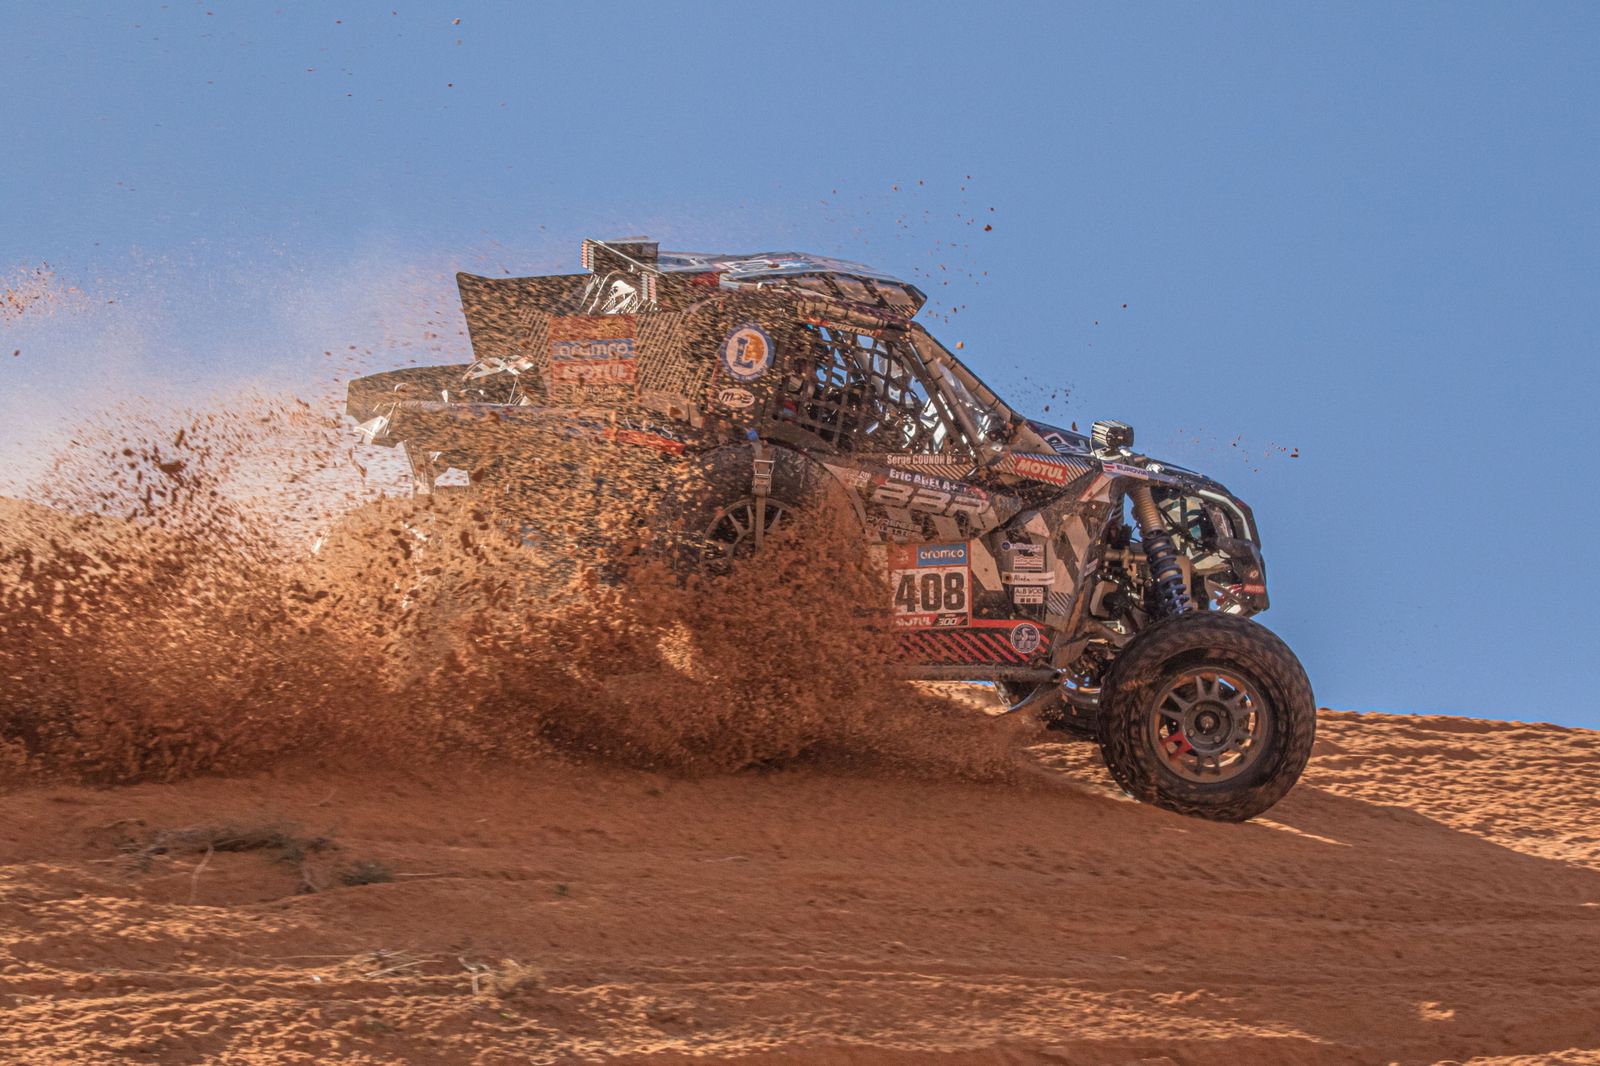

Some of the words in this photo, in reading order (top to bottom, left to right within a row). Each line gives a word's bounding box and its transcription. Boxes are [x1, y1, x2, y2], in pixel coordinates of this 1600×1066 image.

[886, 454, 912, 465] Serge
[946, 455, 958, 465] B+
[1016, 459, 1064, 480] MOTUL
[1116, 465, 1148, 476] EUROVIA
[889, 468, 912, 482] Eric
[942, 481, 959, 491] A+
[920, 549, 965, 560] aramco
[894, 572, 966, 613] 408
